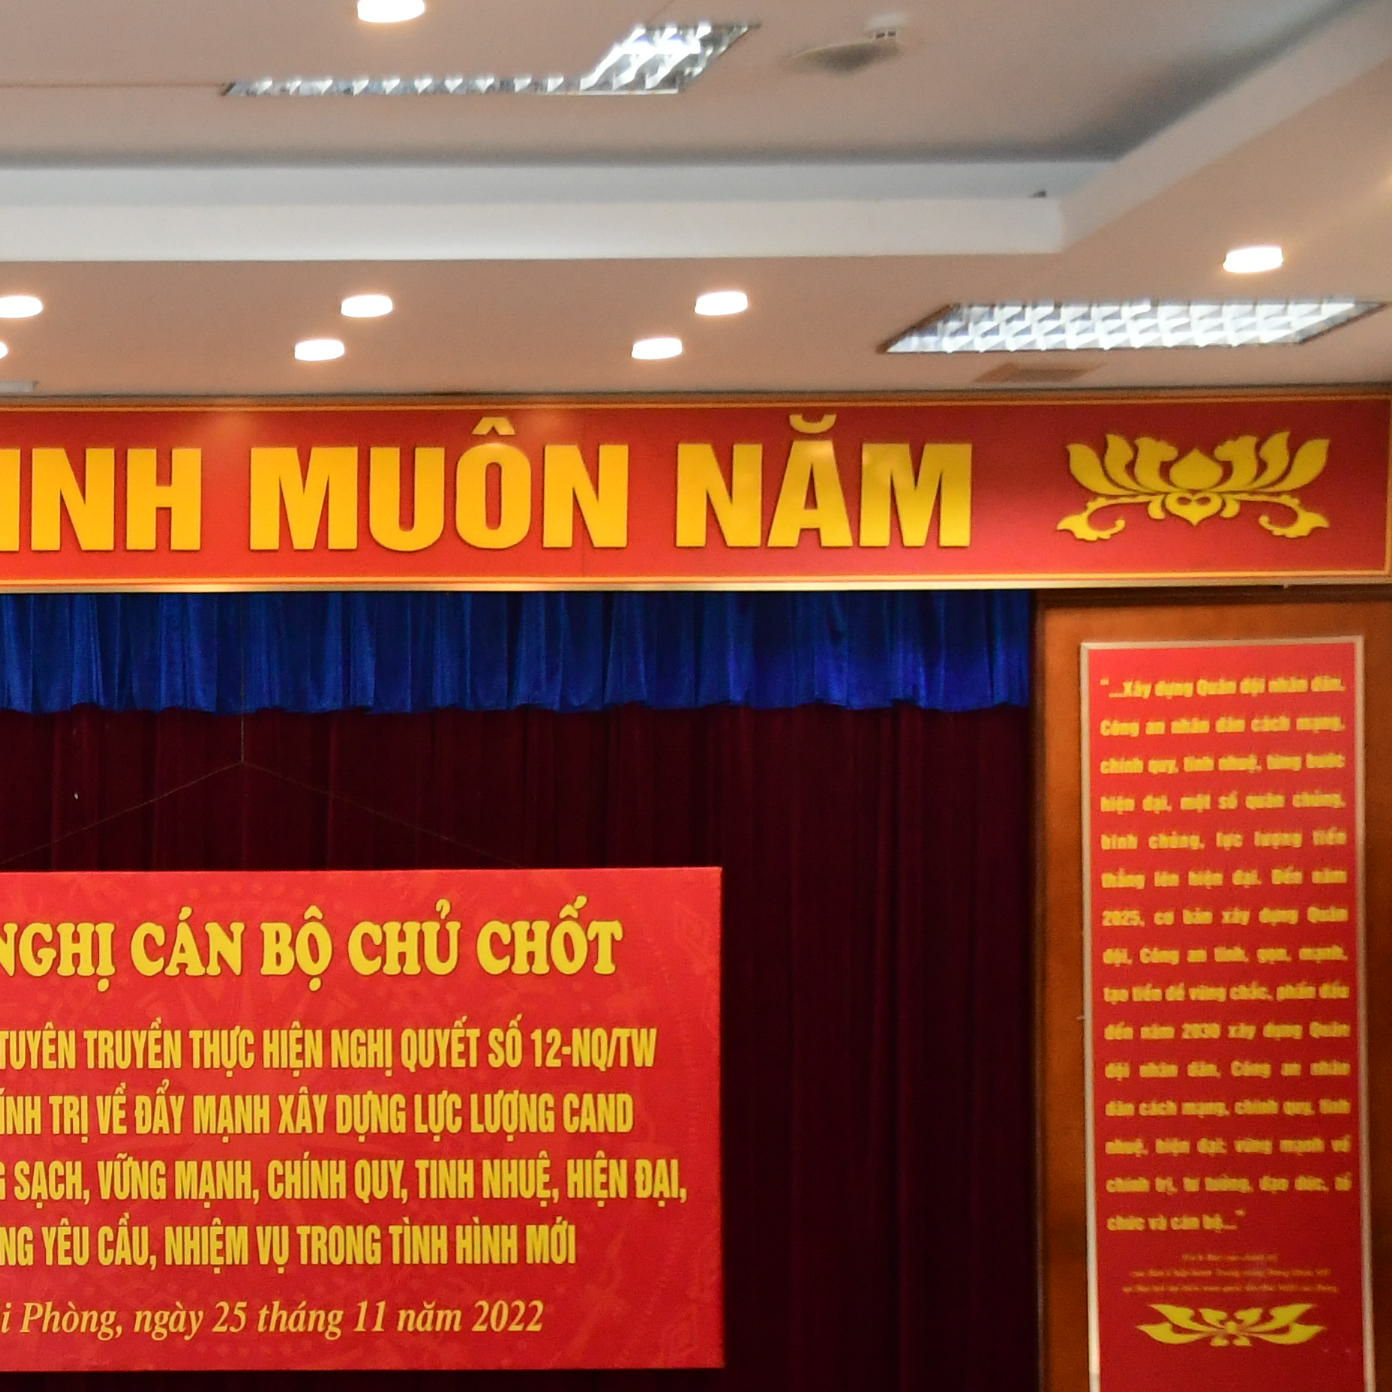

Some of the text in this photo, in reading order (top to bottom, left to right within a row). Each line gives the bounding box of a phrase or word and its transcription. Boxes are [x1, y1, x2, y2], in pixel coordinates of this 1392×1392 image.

[250, 417, 630, 552] MUÔN
[676, 414, 973, 548] NĂM
[130, 907, 246, 978] CÁN
[260, 905, 334, 992] BỘ
[347, 898, 462, 977] CHỦ
[476, 895, 624, 976] CHỐT
[84, 1017, 183, 1071] TRUYỀN
[190, 1025, 256, 1079] THỰC
[263, 1021, 324, 1077] HIỆN
[332, 1028, 394, 1077] NGHỊ
[401, 1015, 482, 1074] QUYẾT
[488, 1013, 524, 1069] SỐ
[532, 1028, 658, 1073] 12-NQ/TW
[49, 1095, 90, 1145] TRỊ
[97, 1083, 128, 1135] VỀ
[135, 1079, 186, 1135] ĐẨY
[194, 1094, 271, 1144] MẠNH
[278, 1087, 329, 1135] XÂY
[336, 1091, 407, 1144] DỰNG
[415, 1091, 463, 1143] LỰC
[470, 1090, 556, 1143] LƯỢNG
[564, 1093, 634, 1134] CAND
[14, 1160, 91, 1210] SẠCH,
[97, 1153, 168, 1201] VỮNG
[174, 1160, 261, 1210] MẠNH,
[267, 1151, 348, 1201] CHÍNH
[354, 1159, 409, 1206] QUY,
[415, 1159, 475, 1200] TINH
[482, 1151, 560, 1209] NHUỆ,
[567, 1151, 629, 1208] HIỆN
[635, 1159, 688, 1209] ĐẠI,
[42, 1218, 91, 1267] YÊU
[97, 1212, 158, 1270] CẦU,
[164, 1218, 250, 1274] NHIỆM
[256, 1225, 290, 1275] VỤ
[296, 1225, 382, 1266] TRONG
[388, 1218, 449, 1266] TÌNH
[456, 1218, 519, 1265] HÌNH
[526, 1216, 577, 1265] MỚI
[21, 1302, 123, 1338] Phòng,
[134, 1310, 206, 1341] ngày
[213, 1301, 248, 1334] 25
[257, 1300, 345, 1340] tháng
[354, 1301, 386, 1333] 11
[397, 1302, 463, 1333] năm
[472, 1300, 545, 1333] 2022
